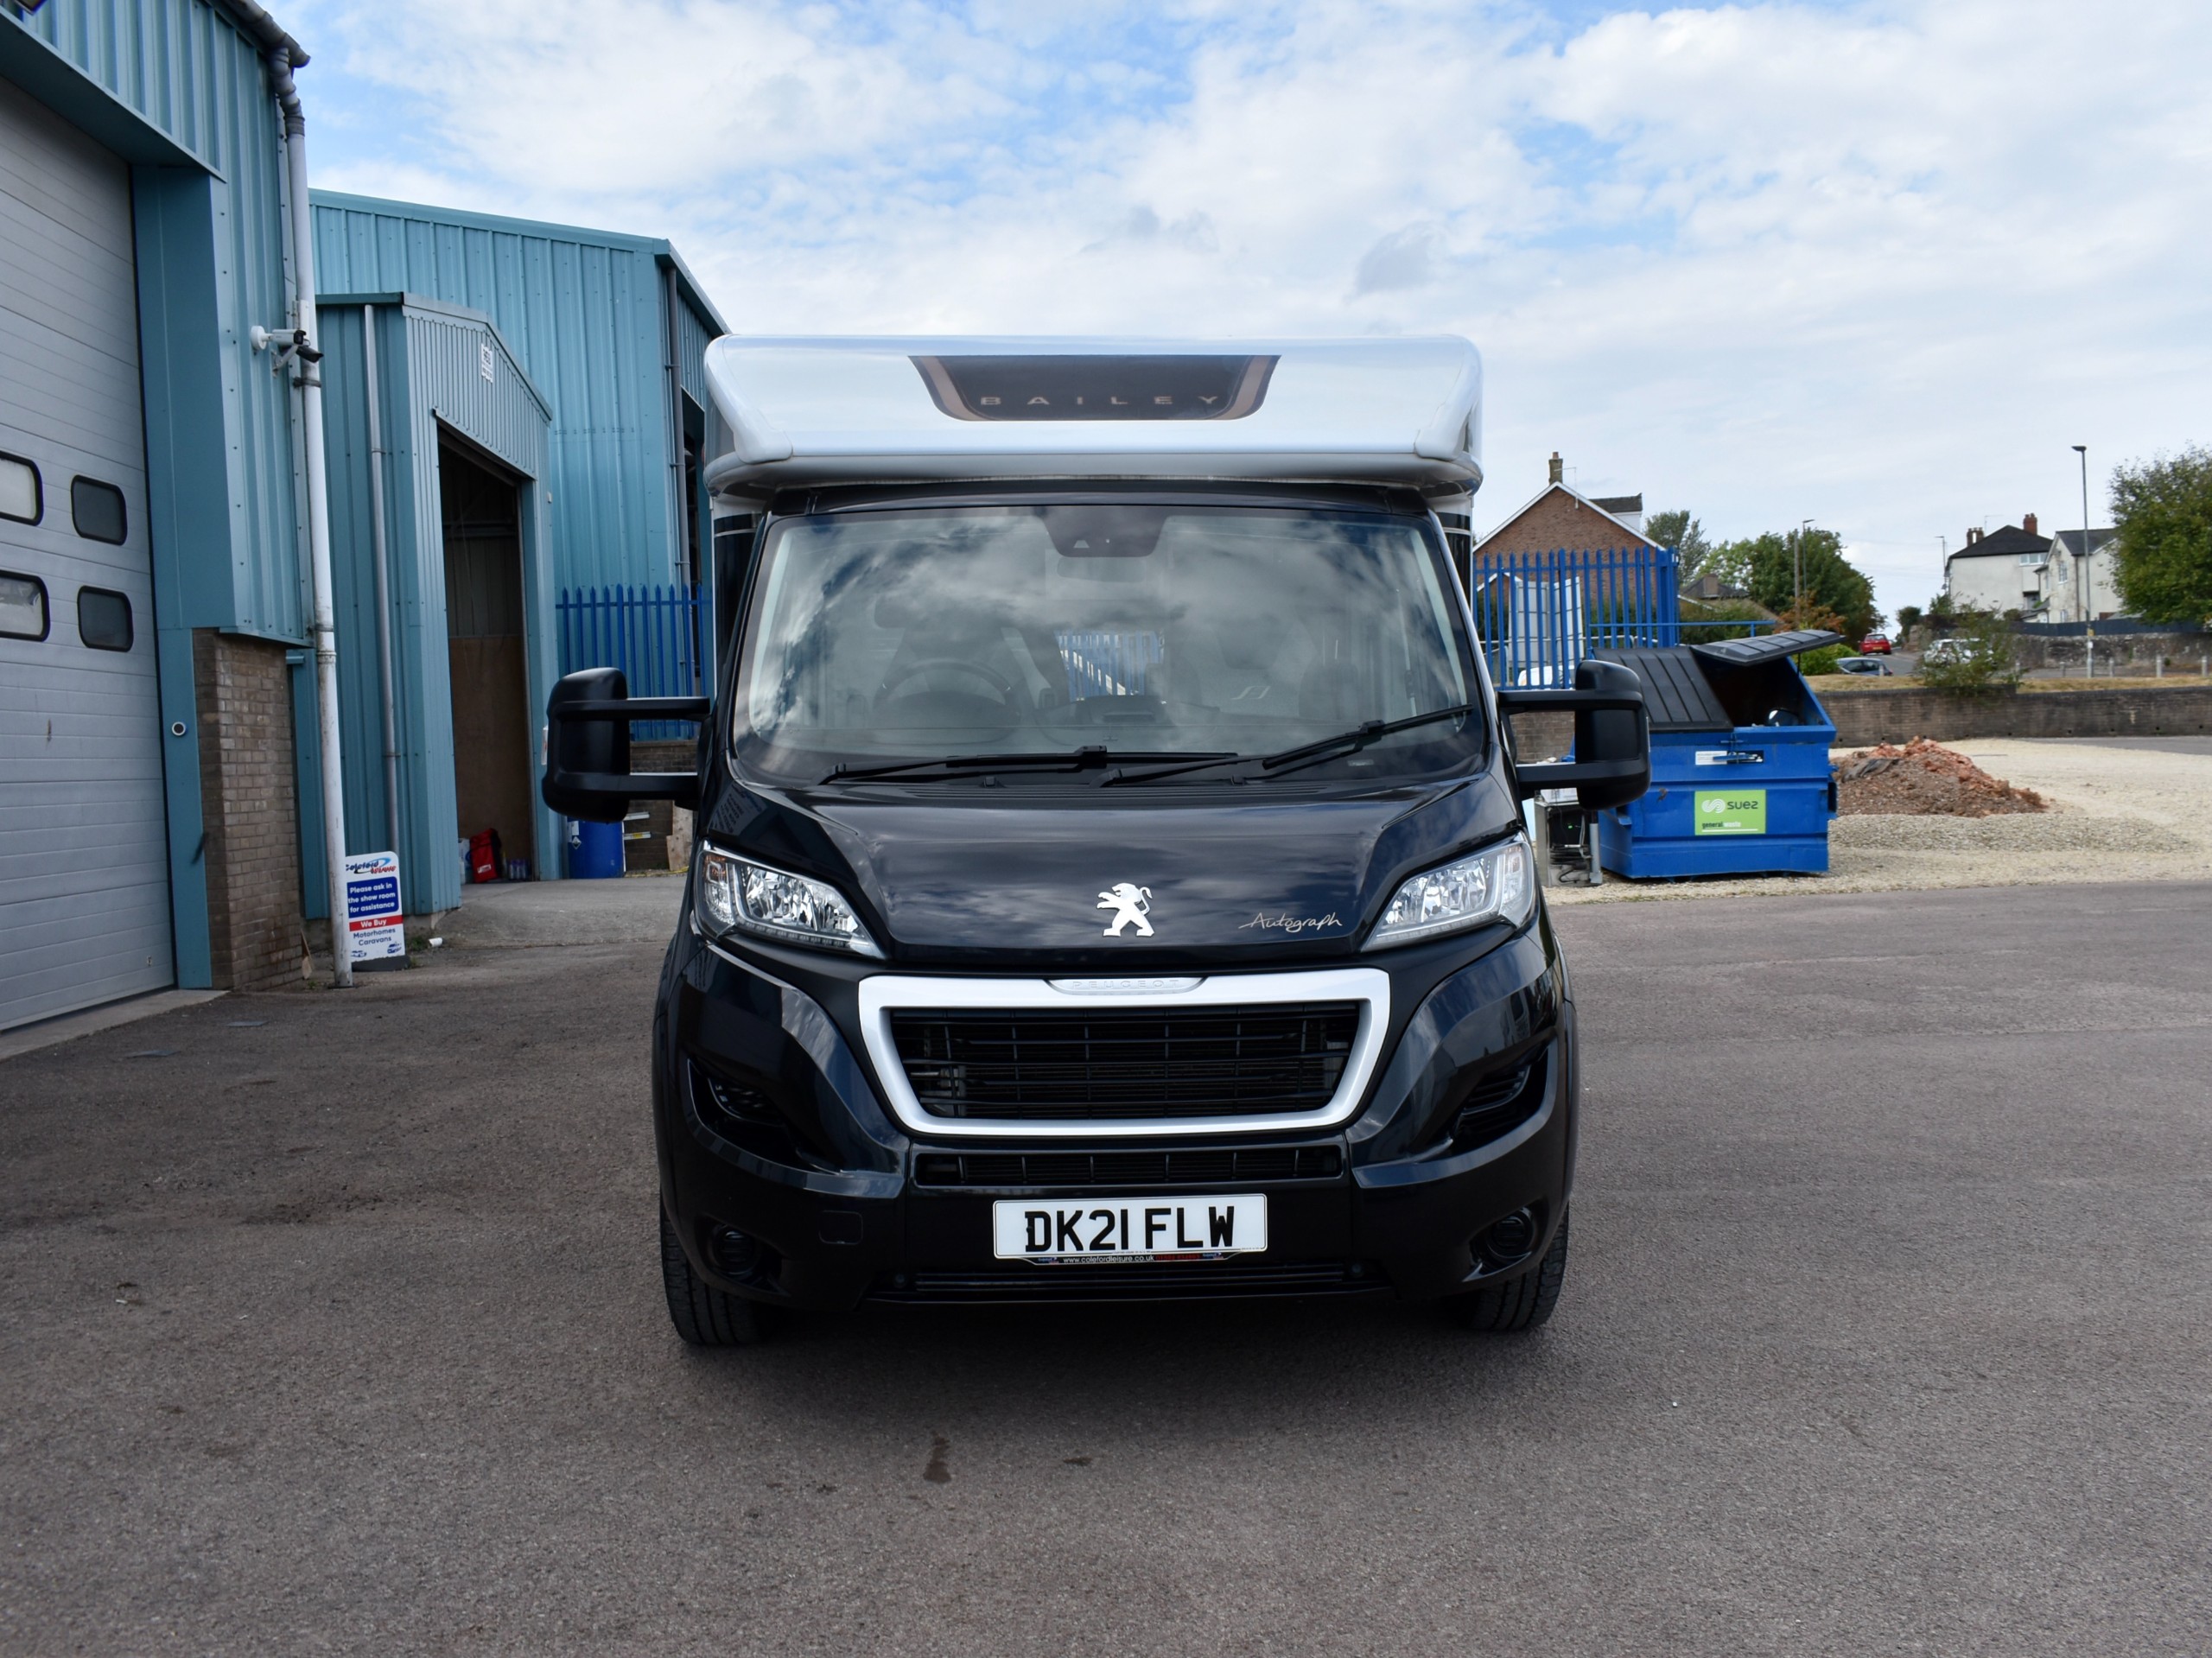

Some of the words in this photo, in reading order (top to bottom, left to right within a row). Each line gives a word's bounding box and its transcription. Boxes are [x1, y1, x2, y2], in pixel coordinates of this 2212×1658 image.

[980, 395, 1219, 406] BAILEY
[1726, 800, 1759, 810] suez
[1701, 821, 1723, 829] general
[360, 901, 395, 912] assistance
[360, 920, 372, 929] We
[373, 918, 387, 928] Buy
[1237, 912, 1343, 933] Autograph
[353, 928, 396, 938] Motorhomes
[359, 936, 391, 945] Caravans
[1072, 979, 1179, 989] PEUGEOT
[1024, 1208, 1129, 1253] DK21
[1144, 1205, 1235, 1250] FLW
[1063, 1254, 1155, 1264] www.colefordleisure.co.uk
